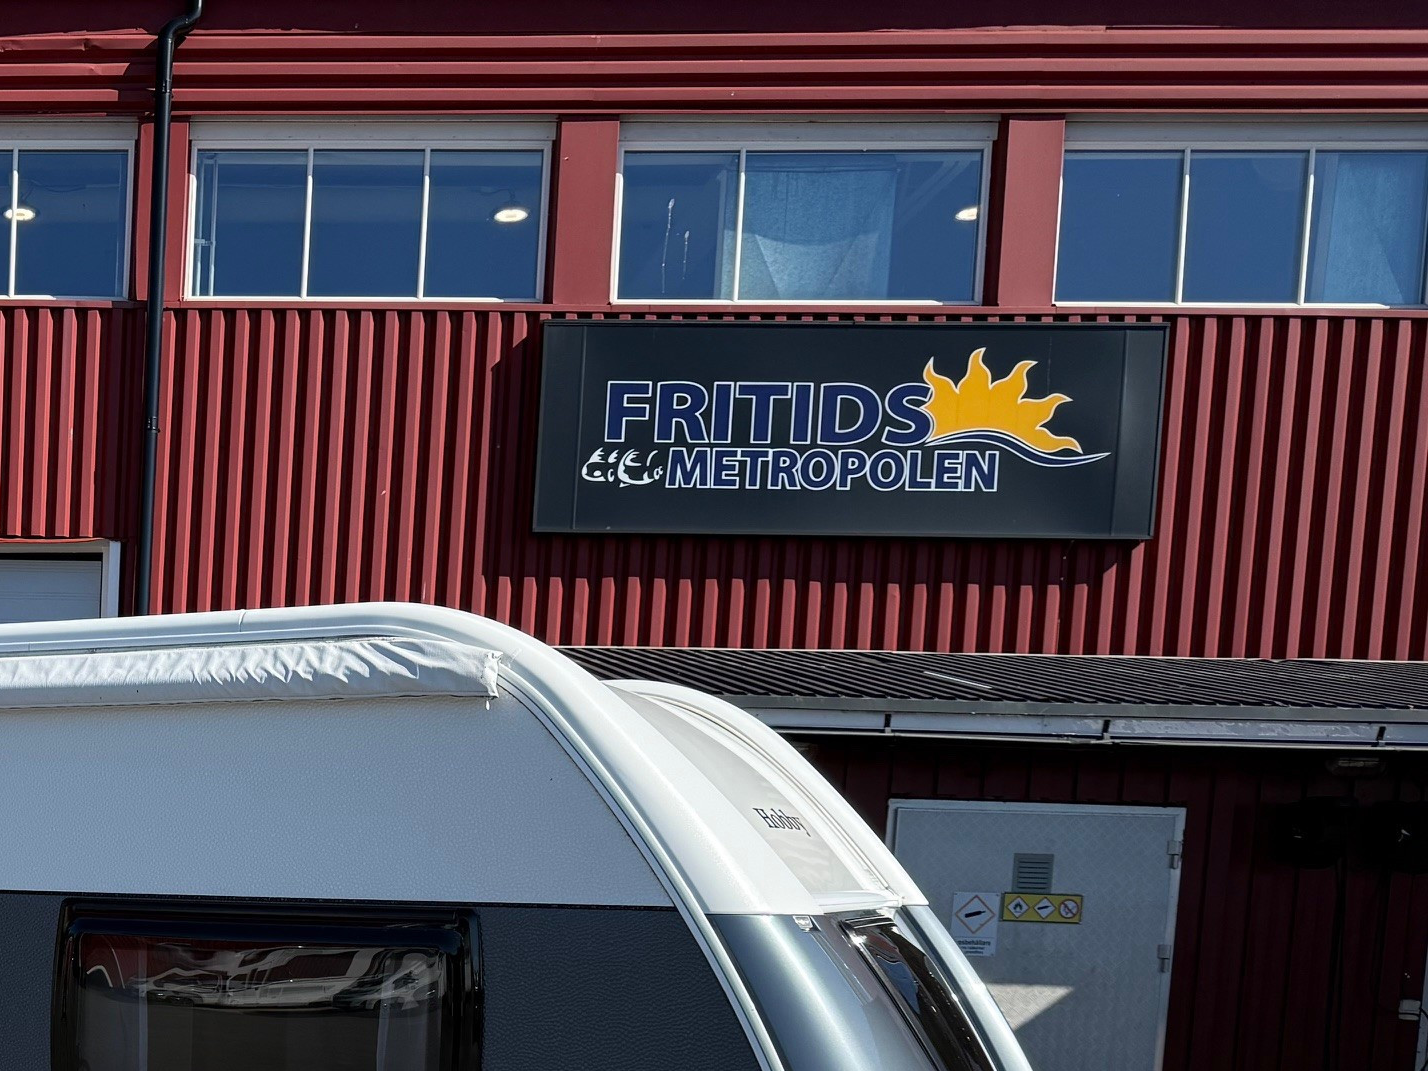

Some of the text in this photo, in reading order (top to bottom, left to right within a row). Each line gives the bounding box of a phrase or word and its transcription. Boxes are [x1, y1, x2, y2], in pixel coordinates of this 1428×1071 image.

[604, 381, 935, 446] FRITIDS
[665, 447, 999, 492] METROPOLEN
[752, 807, 811, 837] Hobby
